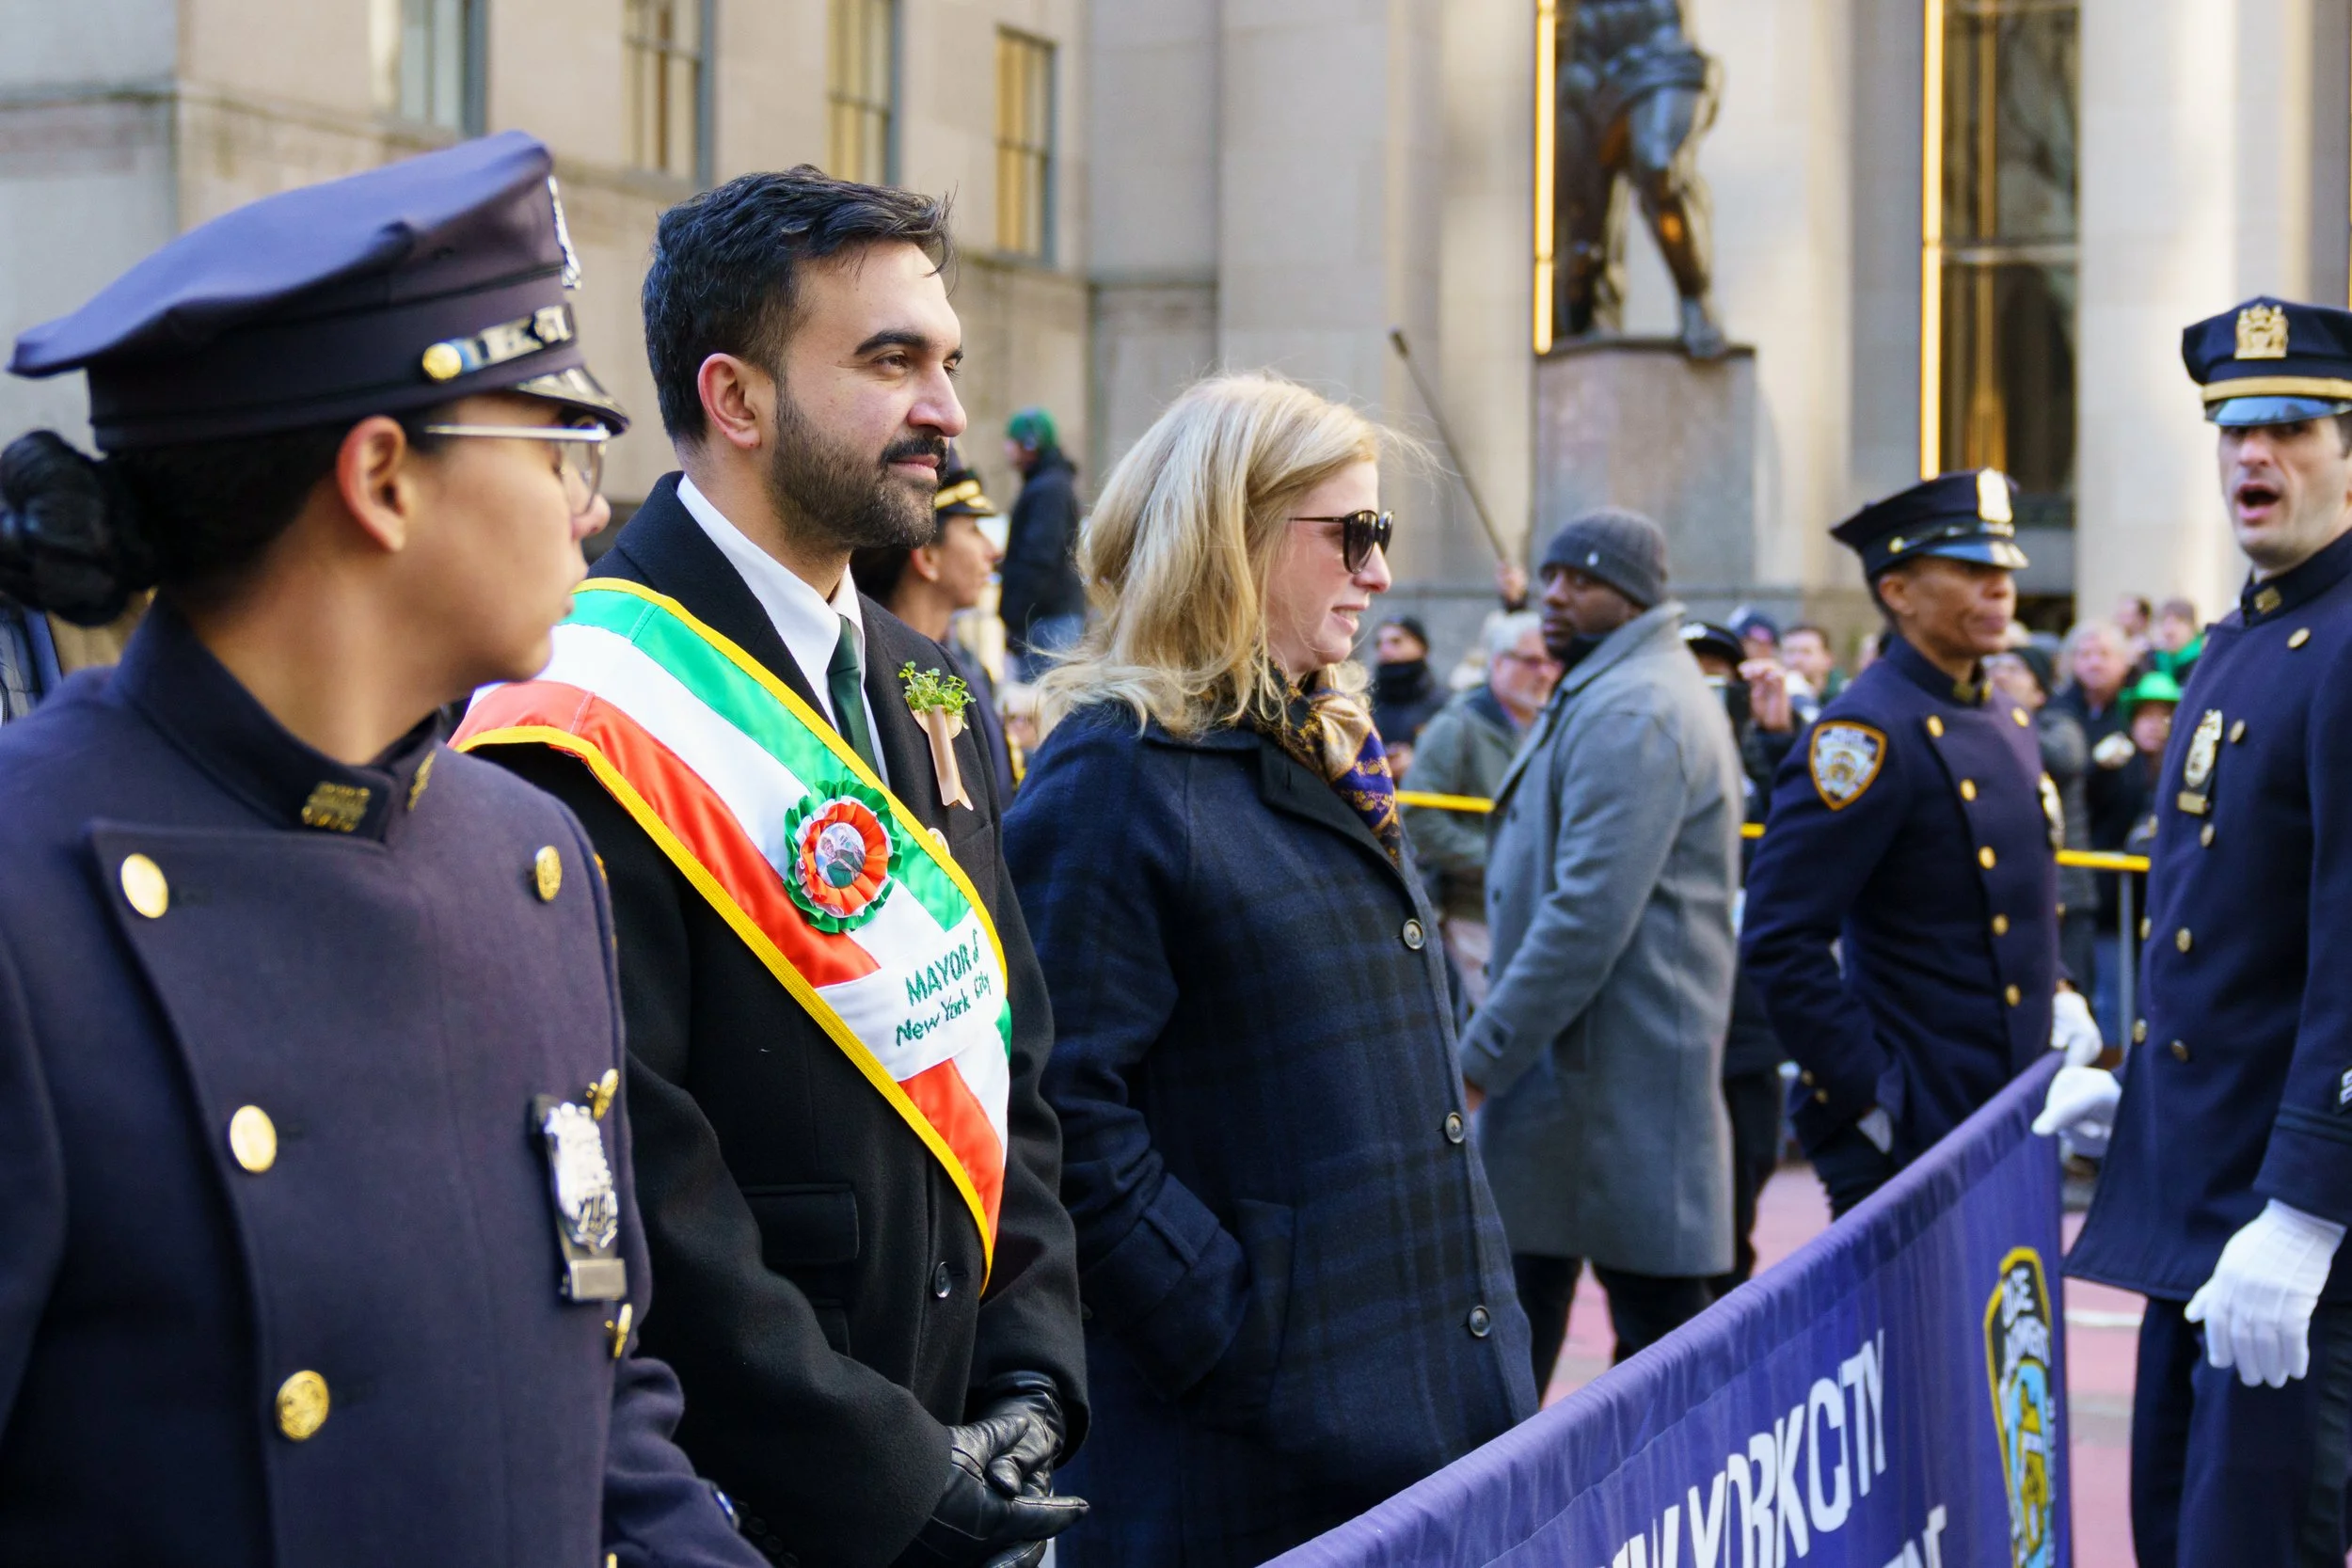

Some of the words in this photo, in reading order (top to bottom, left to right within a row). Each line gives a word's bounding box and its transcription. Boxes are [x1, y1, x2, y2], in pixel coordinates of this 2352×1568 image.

[896, 1012, 940, 1047] New
[941, 988, 971, 1022] York
[973, 970, 992, 999] City
[905, 942, 973, 1006] MAYOR
[1688, 1403, 1810, 1568] YORK
[1808, 1328, 1887, 1533] CTY
